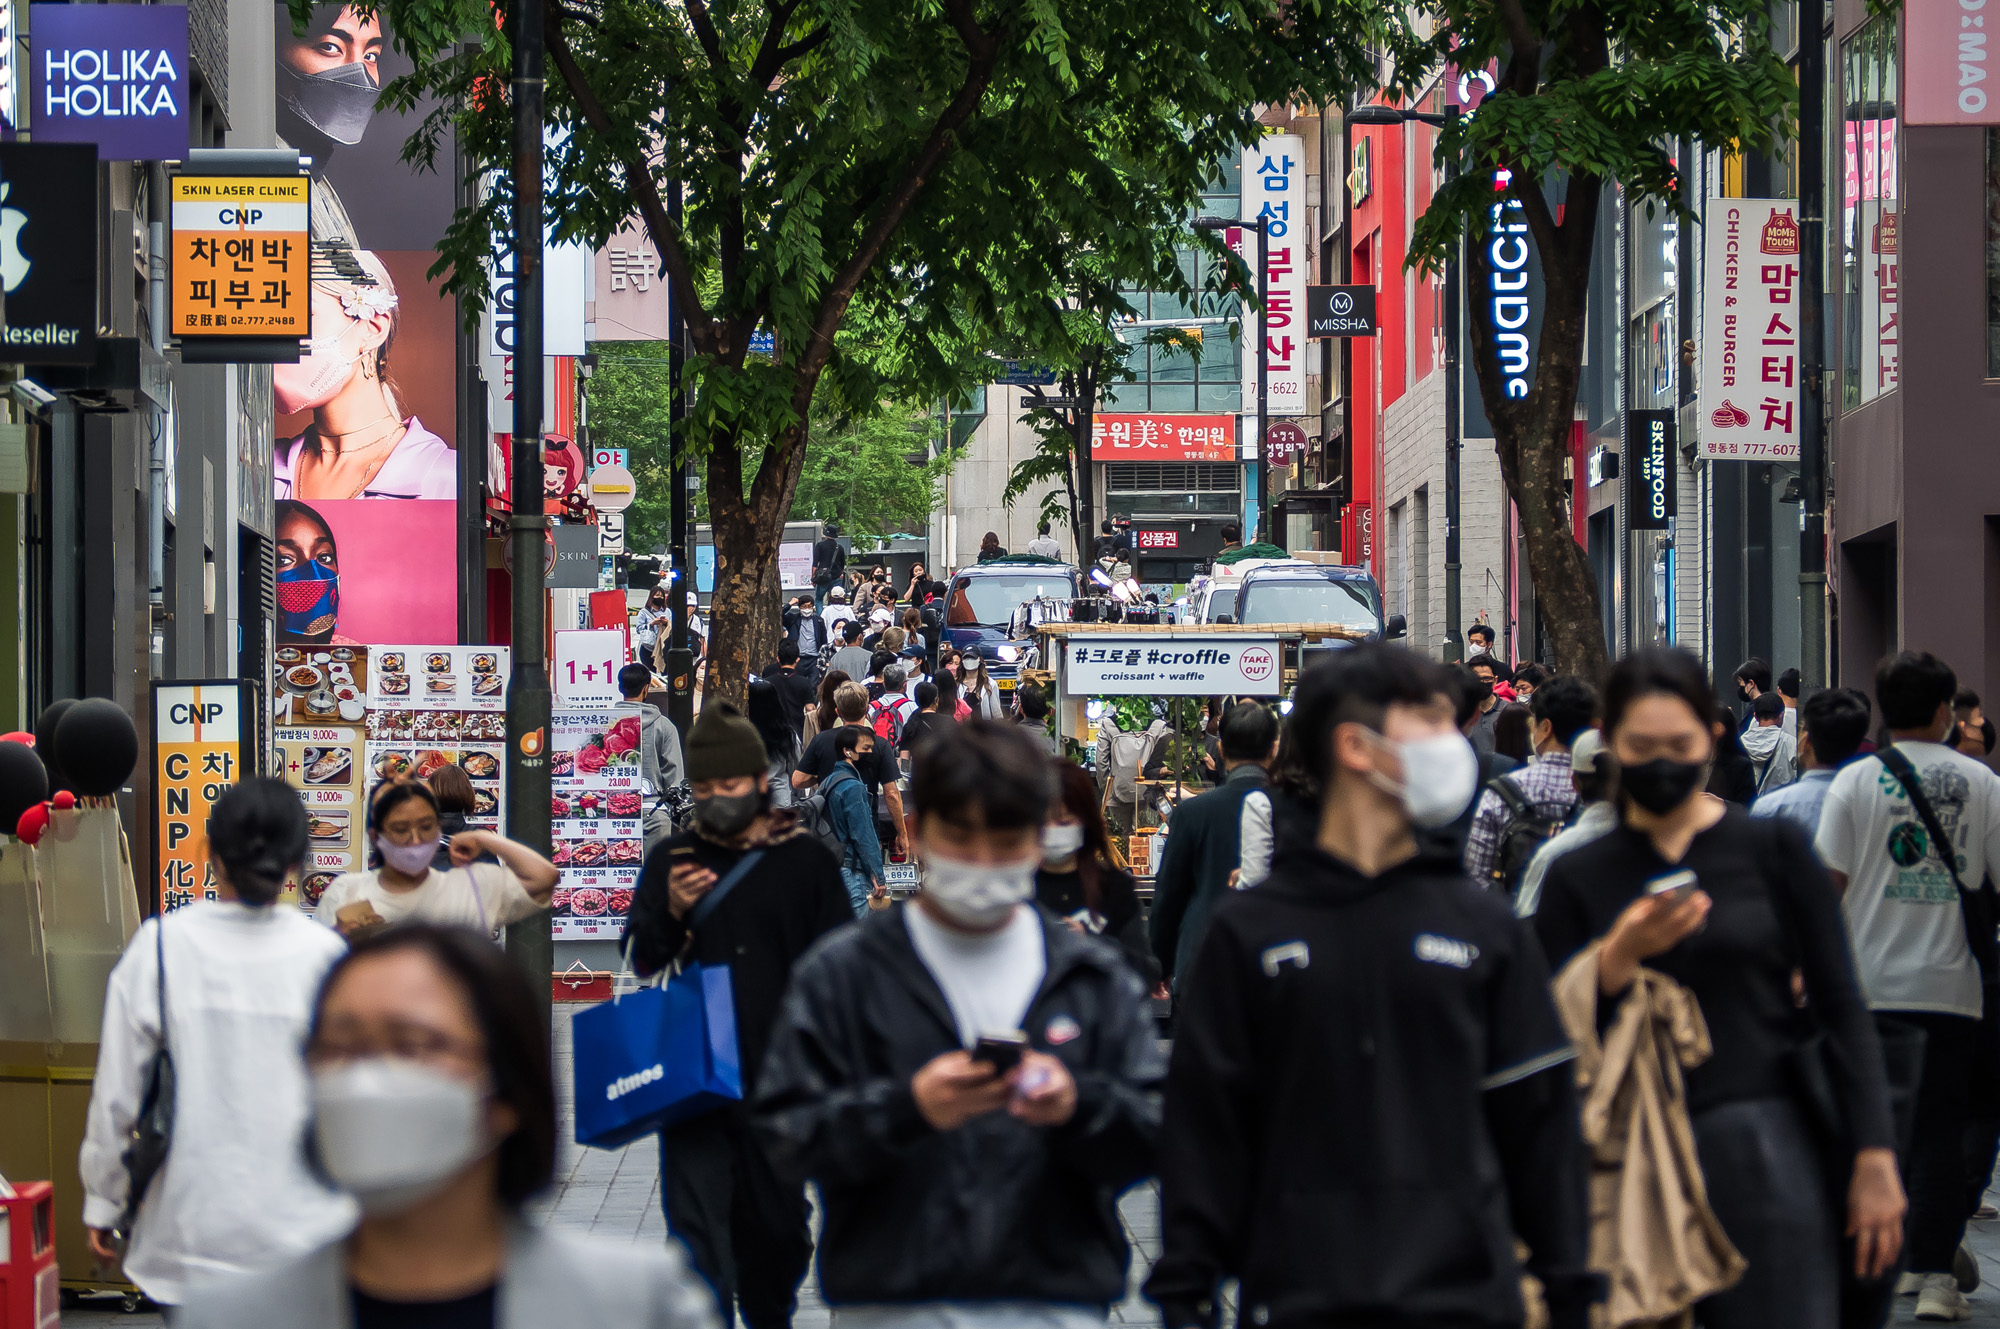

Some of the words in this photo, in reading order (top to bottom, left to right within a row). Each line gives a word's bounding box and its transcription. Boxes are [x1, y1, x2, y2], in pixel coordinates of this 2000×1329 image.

[46, 49, 177, 81] HOLIKA
[46, 84, 177, 116] HOLIKA
[182, 185, 211, 195] SKIN
[215, 186, 255, 195] LASER
[259, 186, 299, 196] CLINIC
[218, 209, 263, 225] CNP
[1725, 208, 1740, 290] CHICKEN
[1765, 237, 1795, 247] TOUCH
[189, 238, 292, 273] 차앤박
[608, 245, 655, 292] 詩
[189, 279, 292, 310] 피부과
[1725, 296, 1737, 308] &
[231, 316, 295, 325] 02.777.2488
[1314, 318, 1370, 331] MISSHA
[1722, 314, 1737, 388] BURGER
[1760, 263, 1799, 434] 맘스터치
[1250, 382, 1298, 395] 7-6622
[1177, 427, 1225, 446] 한의원
[1707, 442, 1738, 454] 명동점
[1643, 456, 1651, 480] 1957
[1651, 420, 1665, 519] SKINFOOD
[1140, 531, 1177, 546] 상품권
[559, 552, 588, 560] SKIN
[1075, 648, 1141, 666] #크로플
[1147, 649, 1231, 665] #croffle
[1242, 655, 1270, 664] TAKE
[565, 660, 613, 685] 1+1
[1101, 672, 1155, 681] croissant
[1169, 672, 1205, 681] waffle
[169, 703, 223, 725] CNP
[601, 767, 615, 777] 한우
[890, 871, 914, 879] 8894
